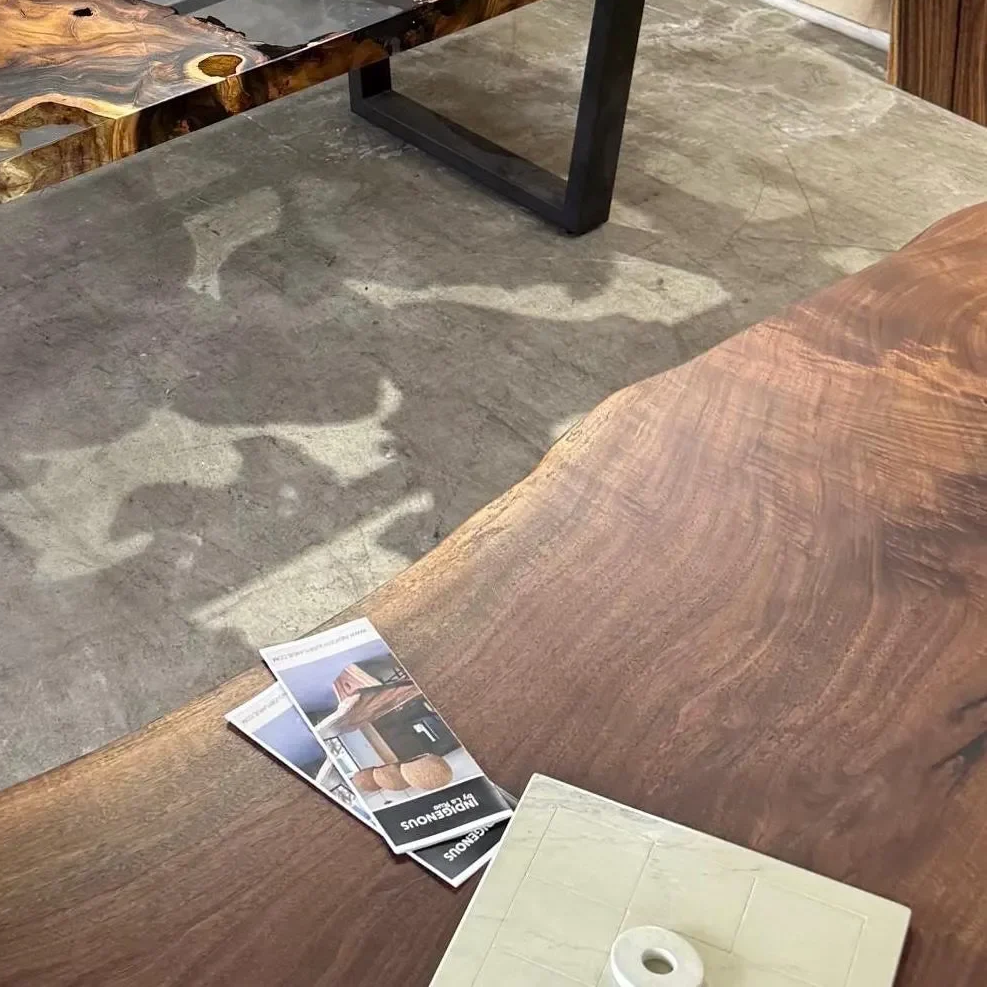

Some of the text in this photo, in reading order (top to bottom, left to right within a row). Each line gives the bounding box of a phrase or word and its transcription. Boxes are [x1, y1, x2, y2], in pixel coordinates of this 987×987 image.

[400, 797, 479, 831] INDIGENOUS
[450, 797, 463, 806] La
[443, 820, 496, 862] IGENOUS
